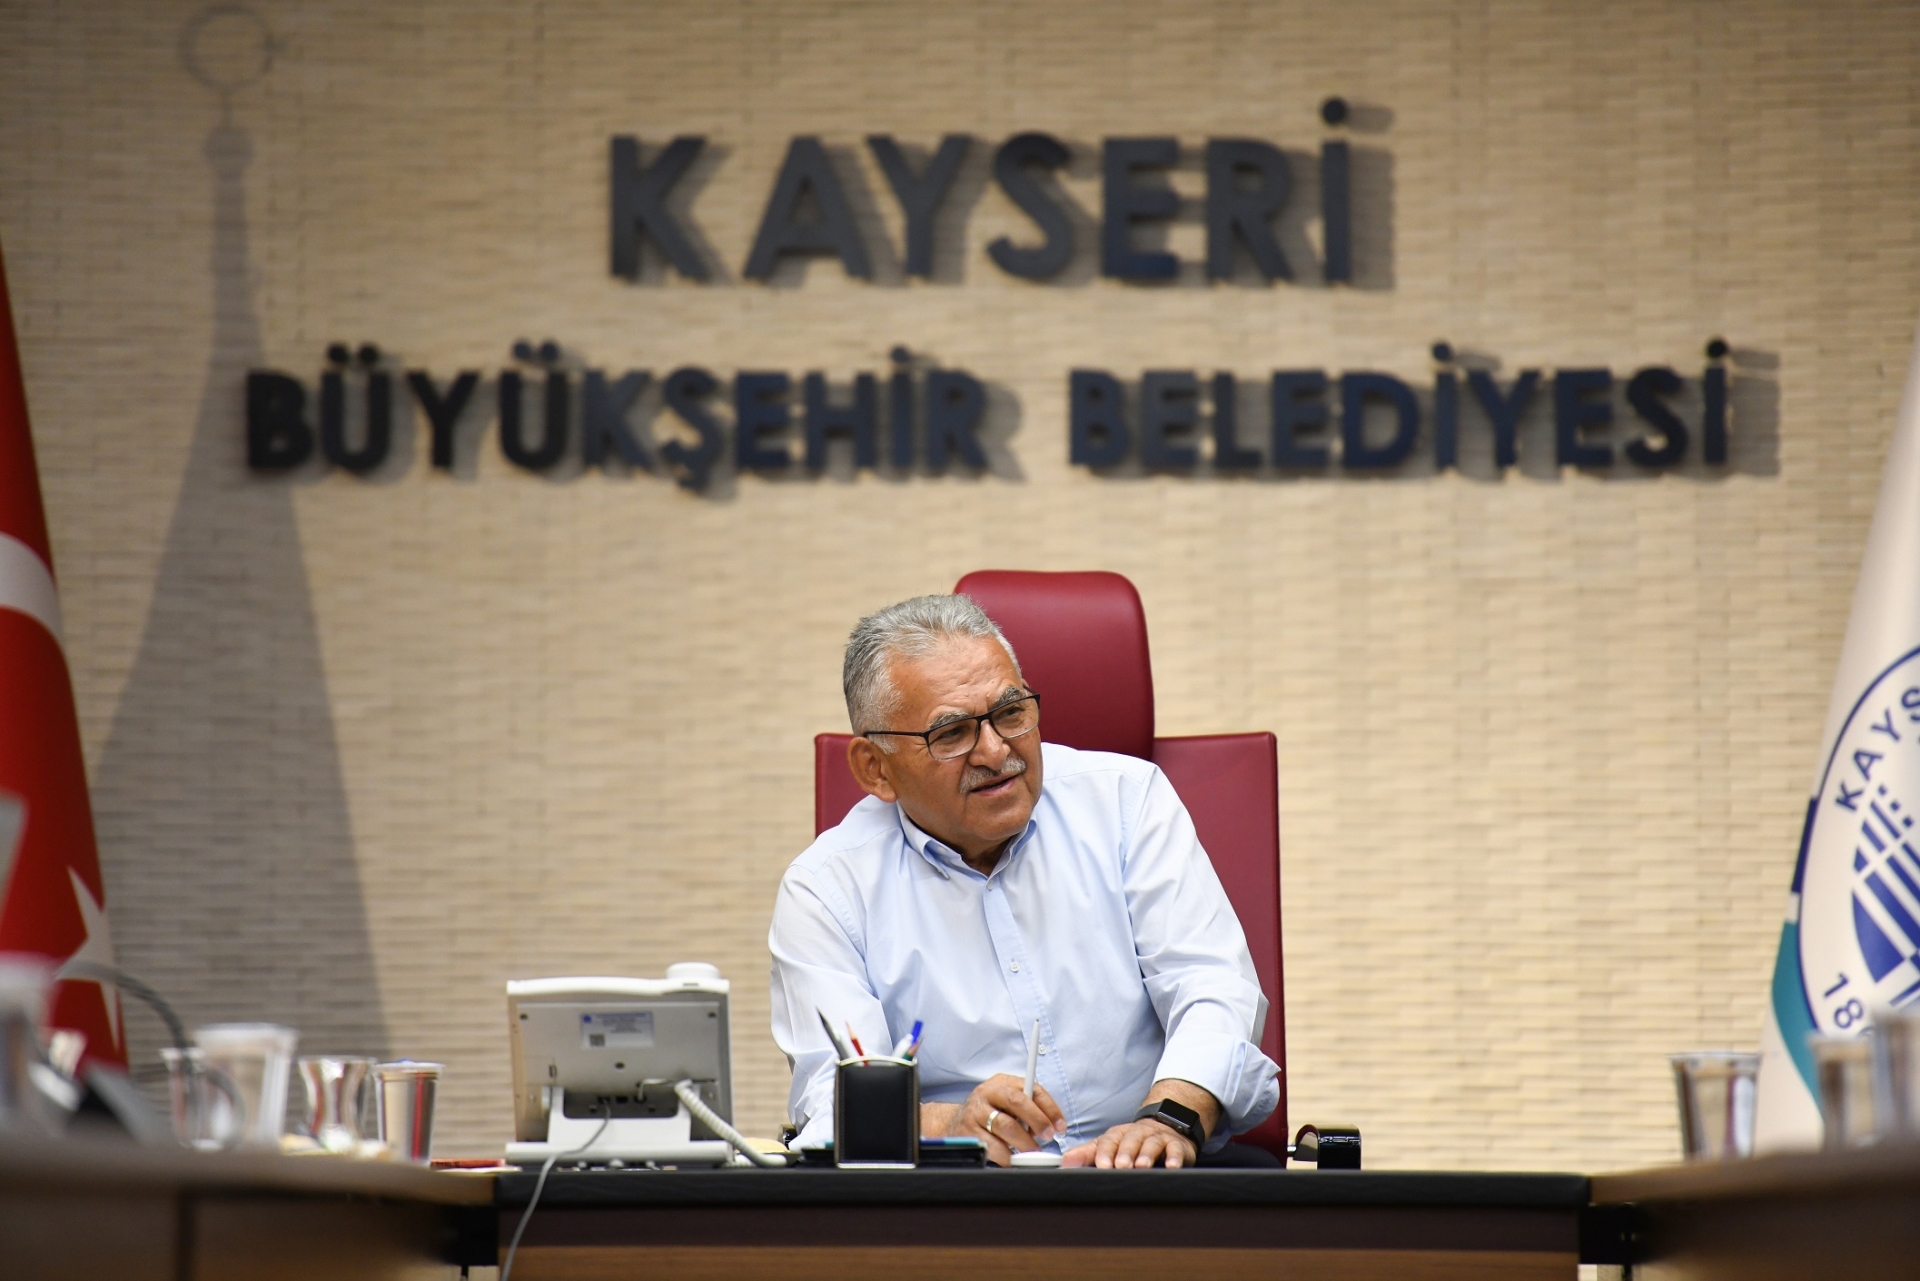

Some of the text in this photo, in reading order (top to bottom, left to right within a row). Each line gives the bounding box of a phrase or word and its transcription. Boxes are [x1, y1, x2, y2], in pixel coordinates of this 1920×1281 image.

[609, 97, 1353, 286] KAYSERİ
[245, 338, 1730, 491] BÜYÜKŞEHİR BELEDİYESİ
